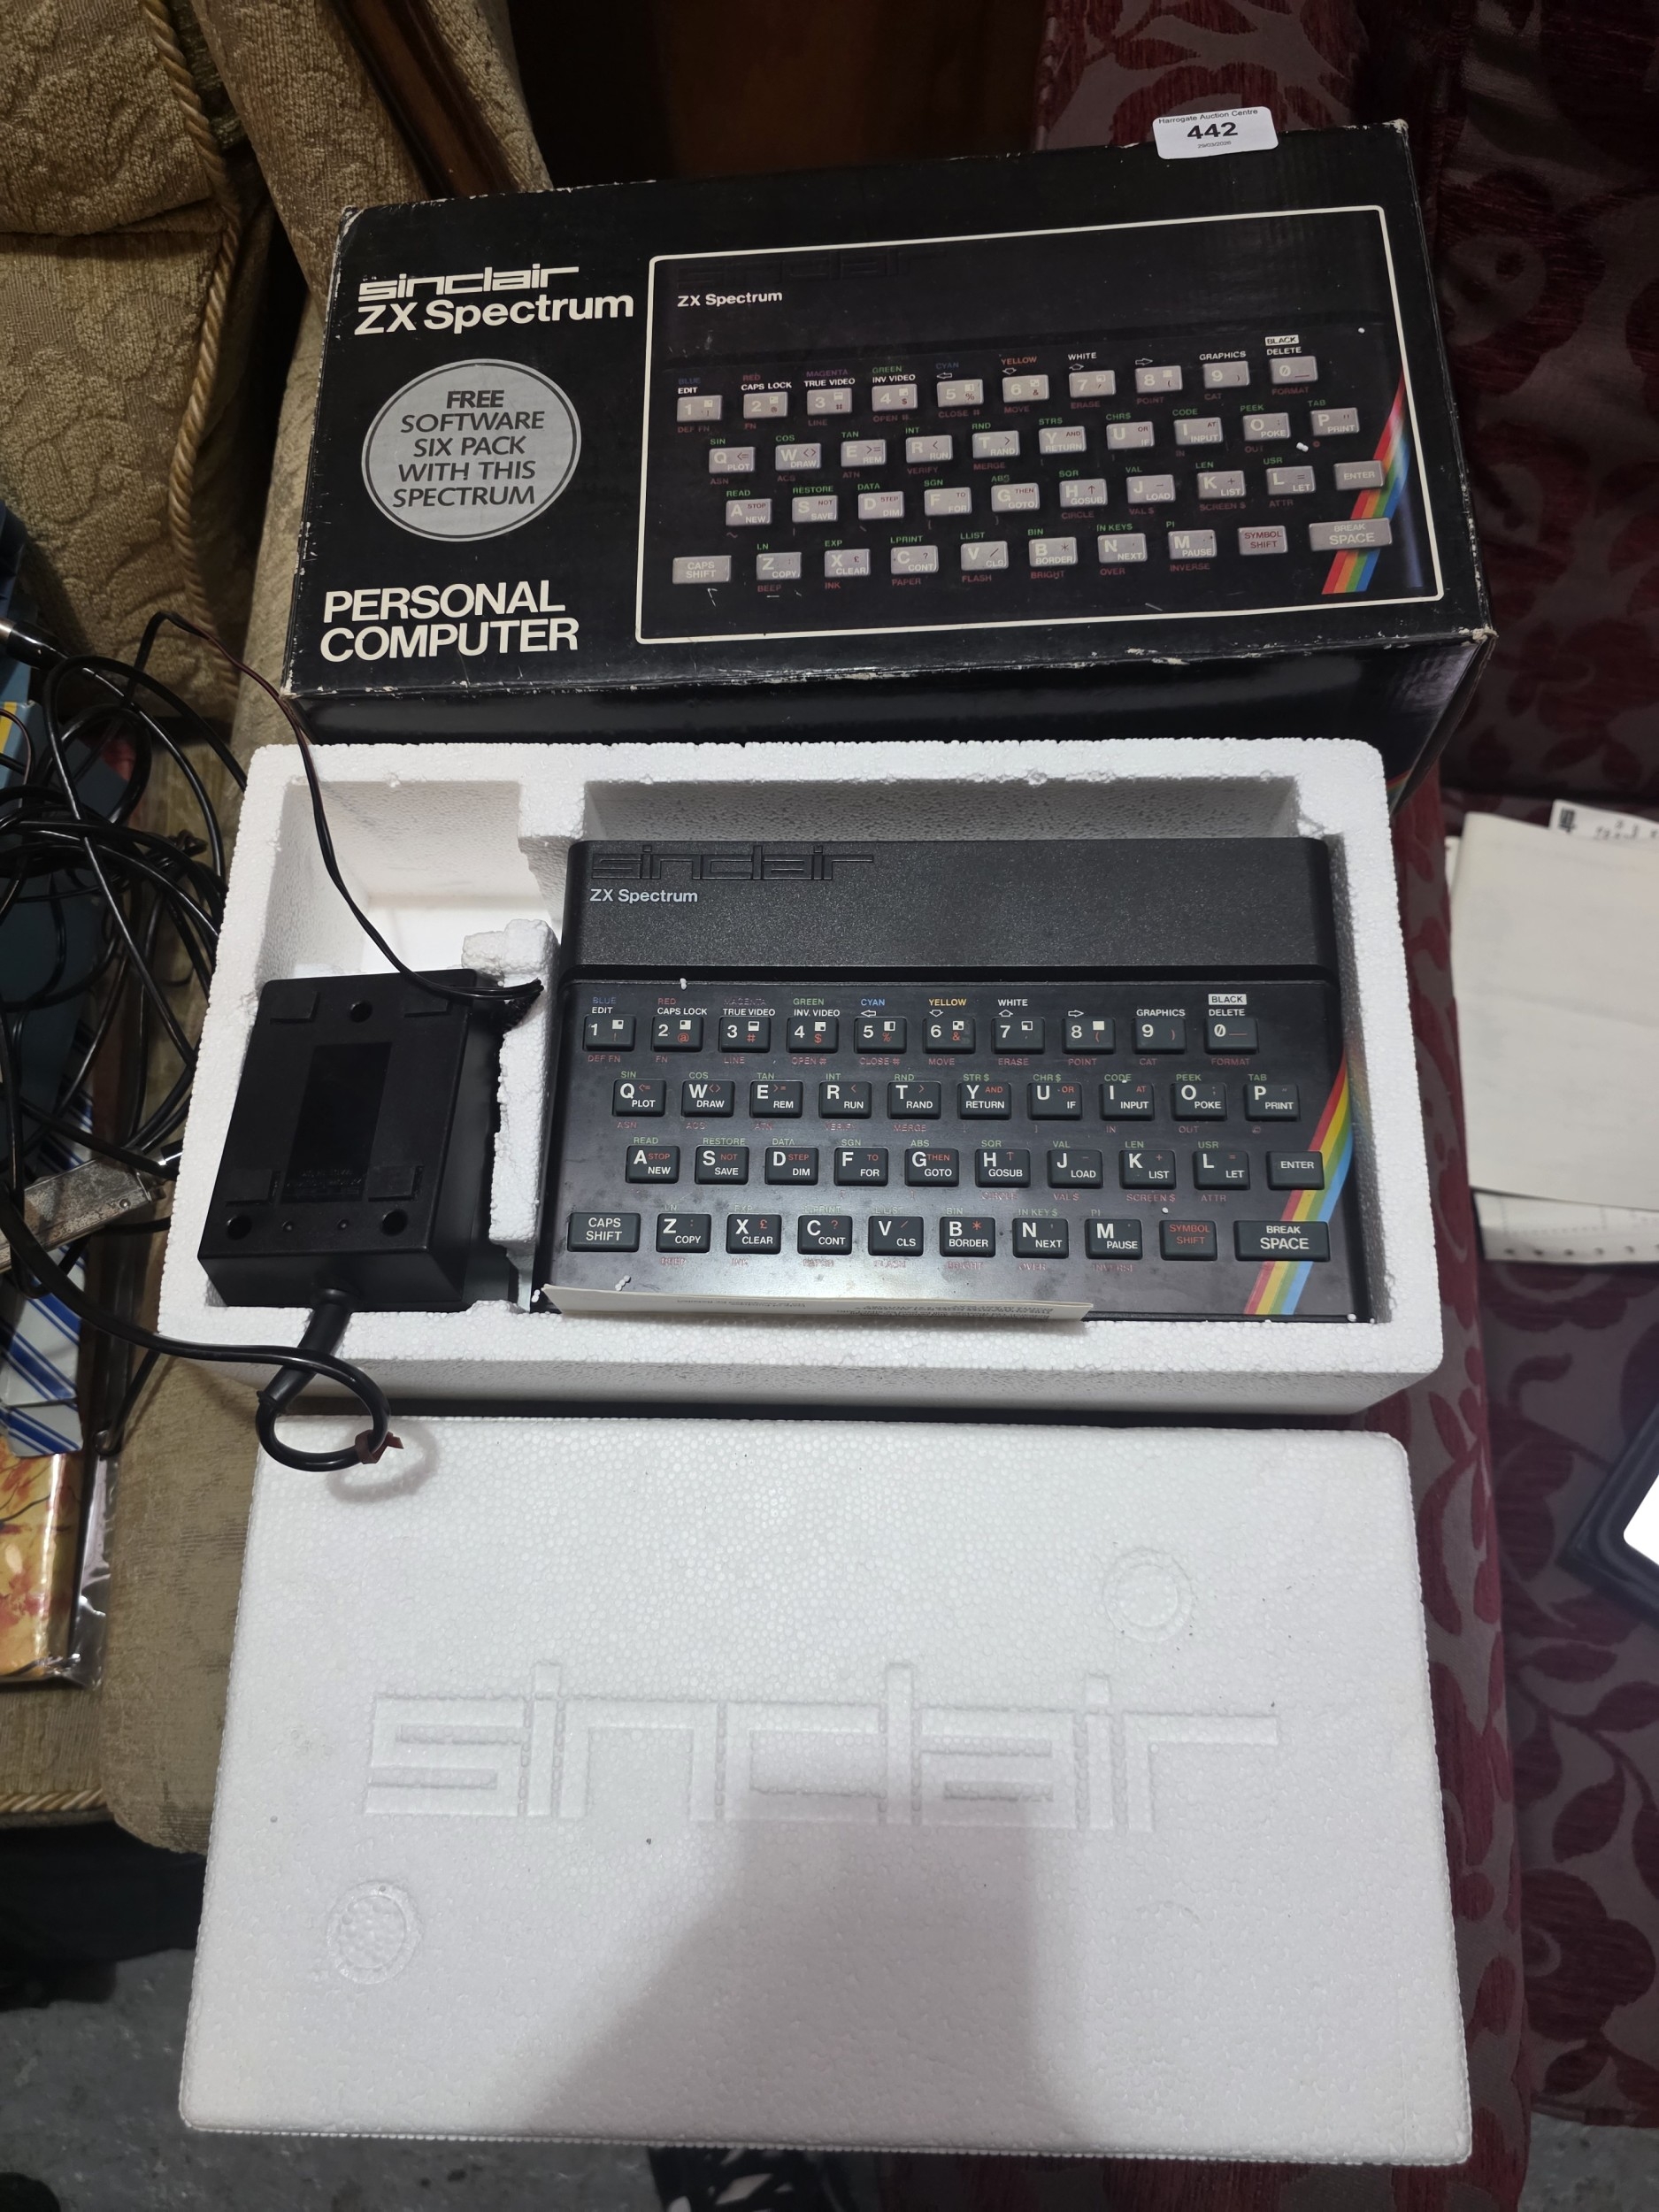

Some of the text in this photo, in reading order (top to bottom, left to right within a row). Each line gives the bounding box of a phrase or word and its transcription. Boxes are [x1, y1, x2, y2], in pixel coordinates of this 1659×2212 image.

[1187, 122, 1238, 139] 442
[358, 264, 579, 302] sinclair
[678, 291, 782, 307] ZX Spectrum
[355, 294, 634, 335] ZX Spectrum
[1200, 351, 1246, 361] GRAPHICS
[741, 382, 764, 391] CAPS
[446, 390, 504, 409] FREE
[400, 411, 545, 434] SOFTWARE
[413, 435, 526, 457] SIX PACK
[398, 461, 536, 481] WITH THIS
[1344, 472, 1374, 480] ENTER
[793, 485, 833, 494] RESTORE
[392, 486, 535, 508] SPECTRUM
[1330, 534, 1374, 545] SPACE
[324, 580, 565, 623] PERSONAL
[320, 618, 579, 663] COMPUTER
[592, 844, 874, 880] sinclair
[590, 888, 697, 903] ZX Spectrum
[590, 1023, 598, 1035] 1
[658, 1024, 669, 1037] 2
[727, 1025, 738, 1038] 3
[795, 1025, 805, 1038] 4
[864, 1025, 874, 1038] 5
[931, 1025, 941, 1038] 6
[1001, 1025, 1010, 1038] 7
[1071, 1025, 1082, 1038] 8
[1142, 1025, 1154, 1037] 9
[619, 1083, 634, 1099] Q
[689, 1084, 708, 1098] W
[757, 1085, 769, 1099] E
[827, 1085, 840, 1099] R
[895, 1085, 908, 1099] T
[966, 1085, 979, 1099] Y
[1037, 1086, 1049, 1100] U
[1181, 1085, 1196, 1100] O
[1255, 1086, 1266, 1100] P
[634, 1150, 647, 1164] A
[703, 1150, 715, 1165] S
[773, 1152, 786, 1166] D
[842, 1152, 854, 1166] F
[912, 1152, 926, 1167] G
[983, 1152, 996, 1167] H
[1056, 1153, 1067, 1168] J
[1129, 1154, 1142, 1168] K
[1203, 1154, 1214, 1168] L
[588, 1217, 621, 1228] CAPS
[664, 1218, 677, 1233] Z
[735, 1219, 749, 1234] X
[807, 1220, 820, 1235] C
[879, 1221, 892, 1235] V
[949, 1221, 962, 1237] B
[586, 1232, 622, 1240] SHIFT
[1023, 1223, 1036, 1237] N
[1097, 1223, 1113, 1239] M
[742, 1236, 773, 1245] CLEAR
[1260, 1238, 1309, 1249] SPACE
[365, 1663, 1279, 1832] sinclair
